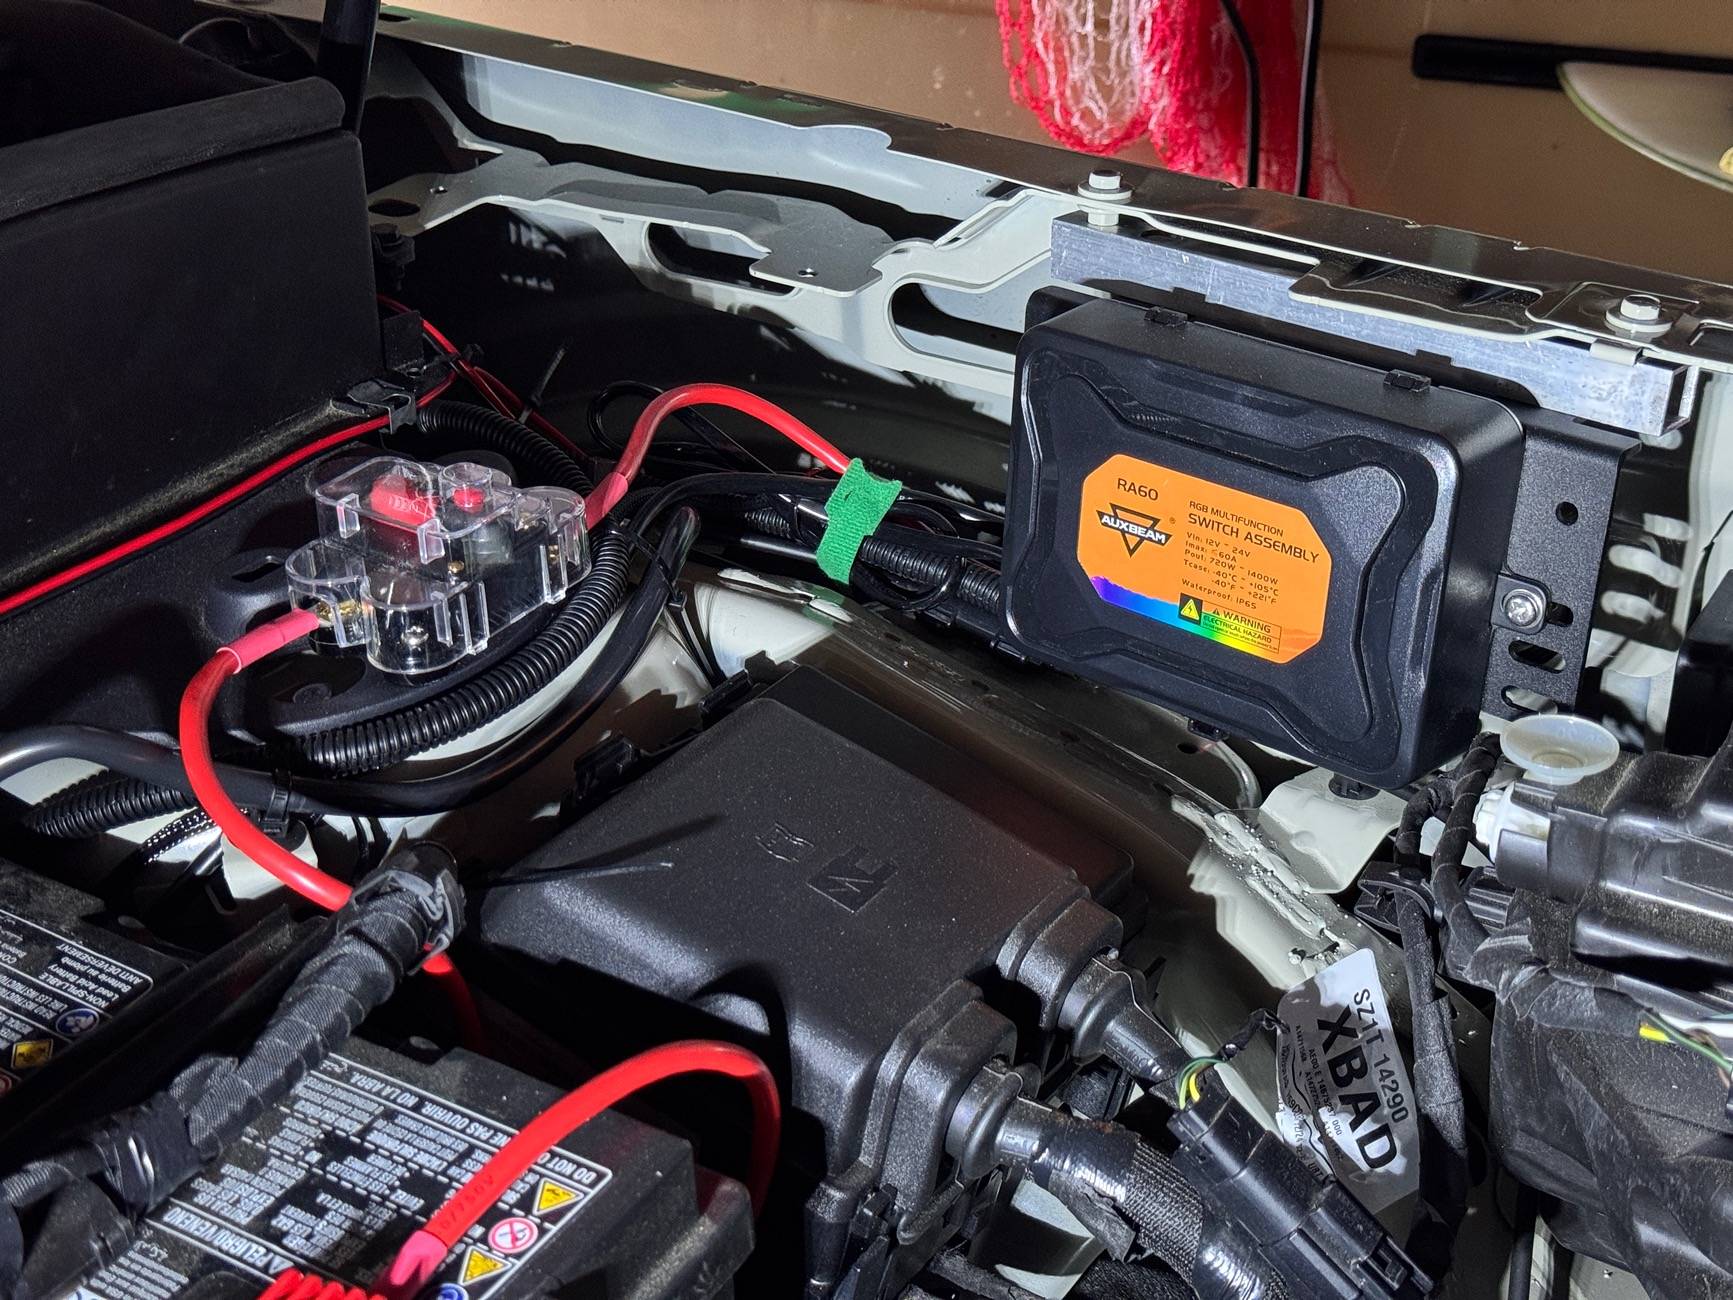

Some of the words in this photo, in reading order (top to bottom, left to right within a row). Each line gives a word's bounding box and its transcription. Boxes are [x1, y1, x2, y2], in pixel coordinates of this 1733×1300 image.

[1117, 477, 1159, 501] RA60
[1100, 514, 1166, 544] AUXBEAM
[1189, 500, 1208, 513] RGB
[1210, 508, 1284, 537] MULTIFUNCTION
[1188, 513, 1239, 539] SWITCH
[1243, 531, 1319, 563] ASSEMBLY
[1206, 538, 1220, 548] 12V
[1232, 547, 1251, 557] 24V
[1210, 557, 1235, 571] 720W
[1247, 570, 1278, 585] 1400W
[1236, 595, 1256, 609] IP65
[1203, 615, 1242, 634] ELECTRICAL
[1243, 629, 1271, 643] HAZARD
[1223, 611, 1271, 633] WARNING
[48, 964, 79, 982] Battery
[76, 978, 98, 990] Acid
[119, 971, 143, 984] ANTI
[38, 972, 109, 1008] NON-SPILLABLE
[96, 987, 119, 1001] Lead
[1353, 988, 1385, 1044] SZ1T
[1373, 1053, 1409, 1123] 14290
[381, 1086, 401, 1099] LA
[1317, 1004, 1398, 1169] XBAD
[421, 1101, 469, 1130] OUVRIR.
[466, 1122, 494, 1140] PAS
[546, 1157, 577, 1176] NOT
[573, 1168, 597, 1184] DO
